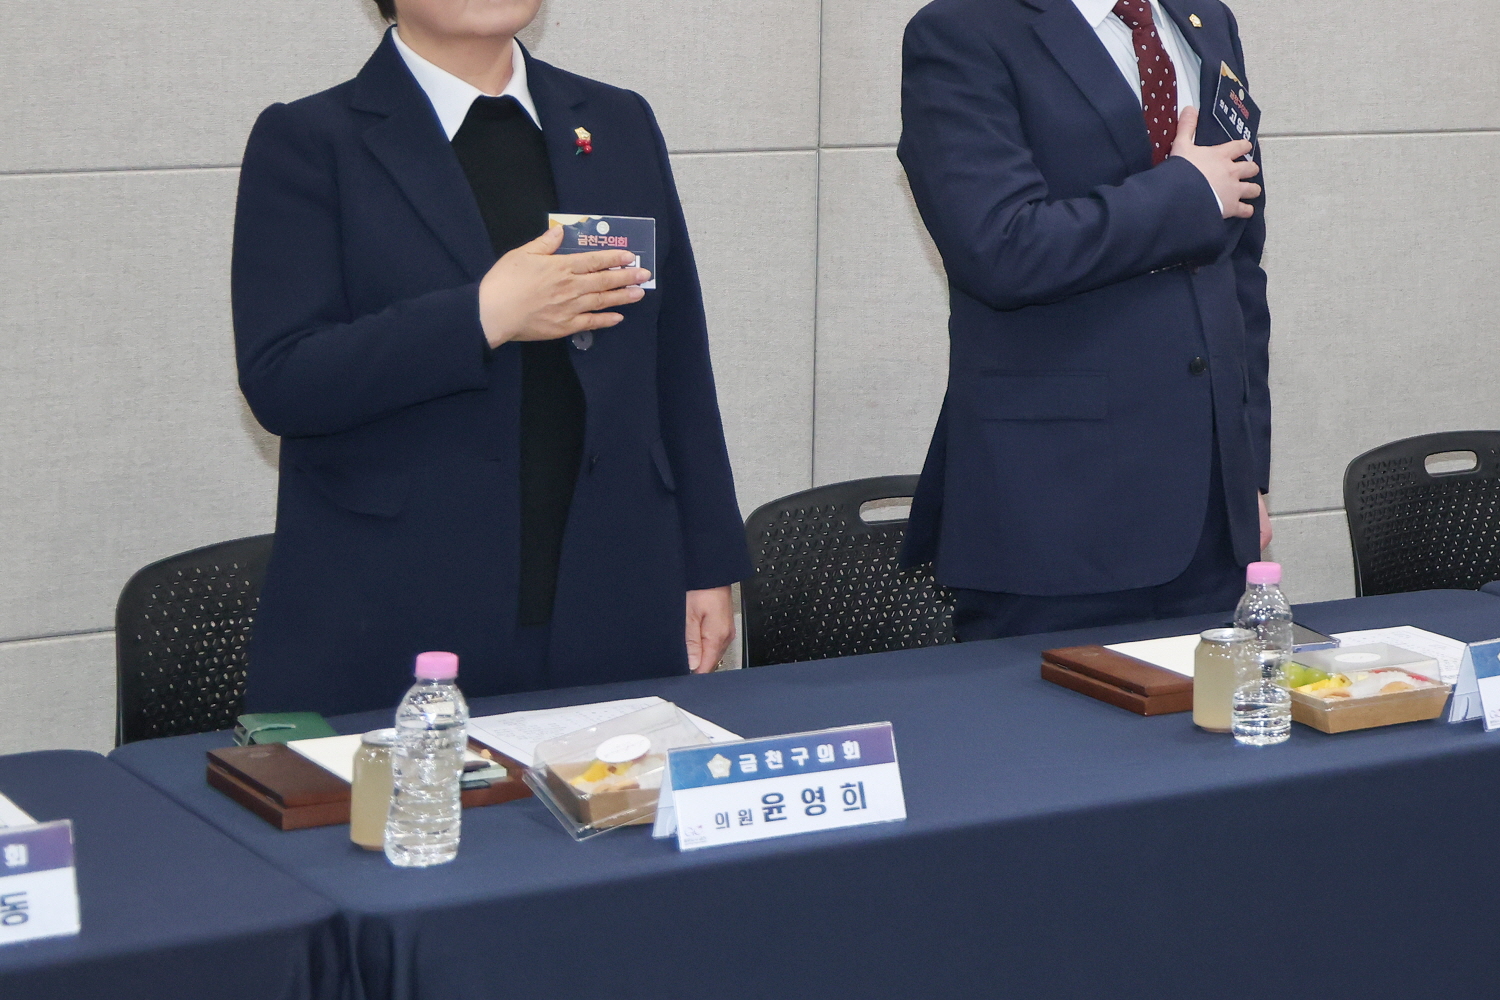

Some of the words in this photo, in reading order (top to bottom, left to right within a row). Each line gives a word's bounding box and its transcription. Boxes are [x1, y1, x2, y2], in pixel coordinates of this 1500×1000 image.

[578, 234, 628, 247] 금천구의회
[738, 740, 860, 774] 금천구의회
[715, 809, 753, 830] 의원
[761, 781, 867, 822] 윤영희
